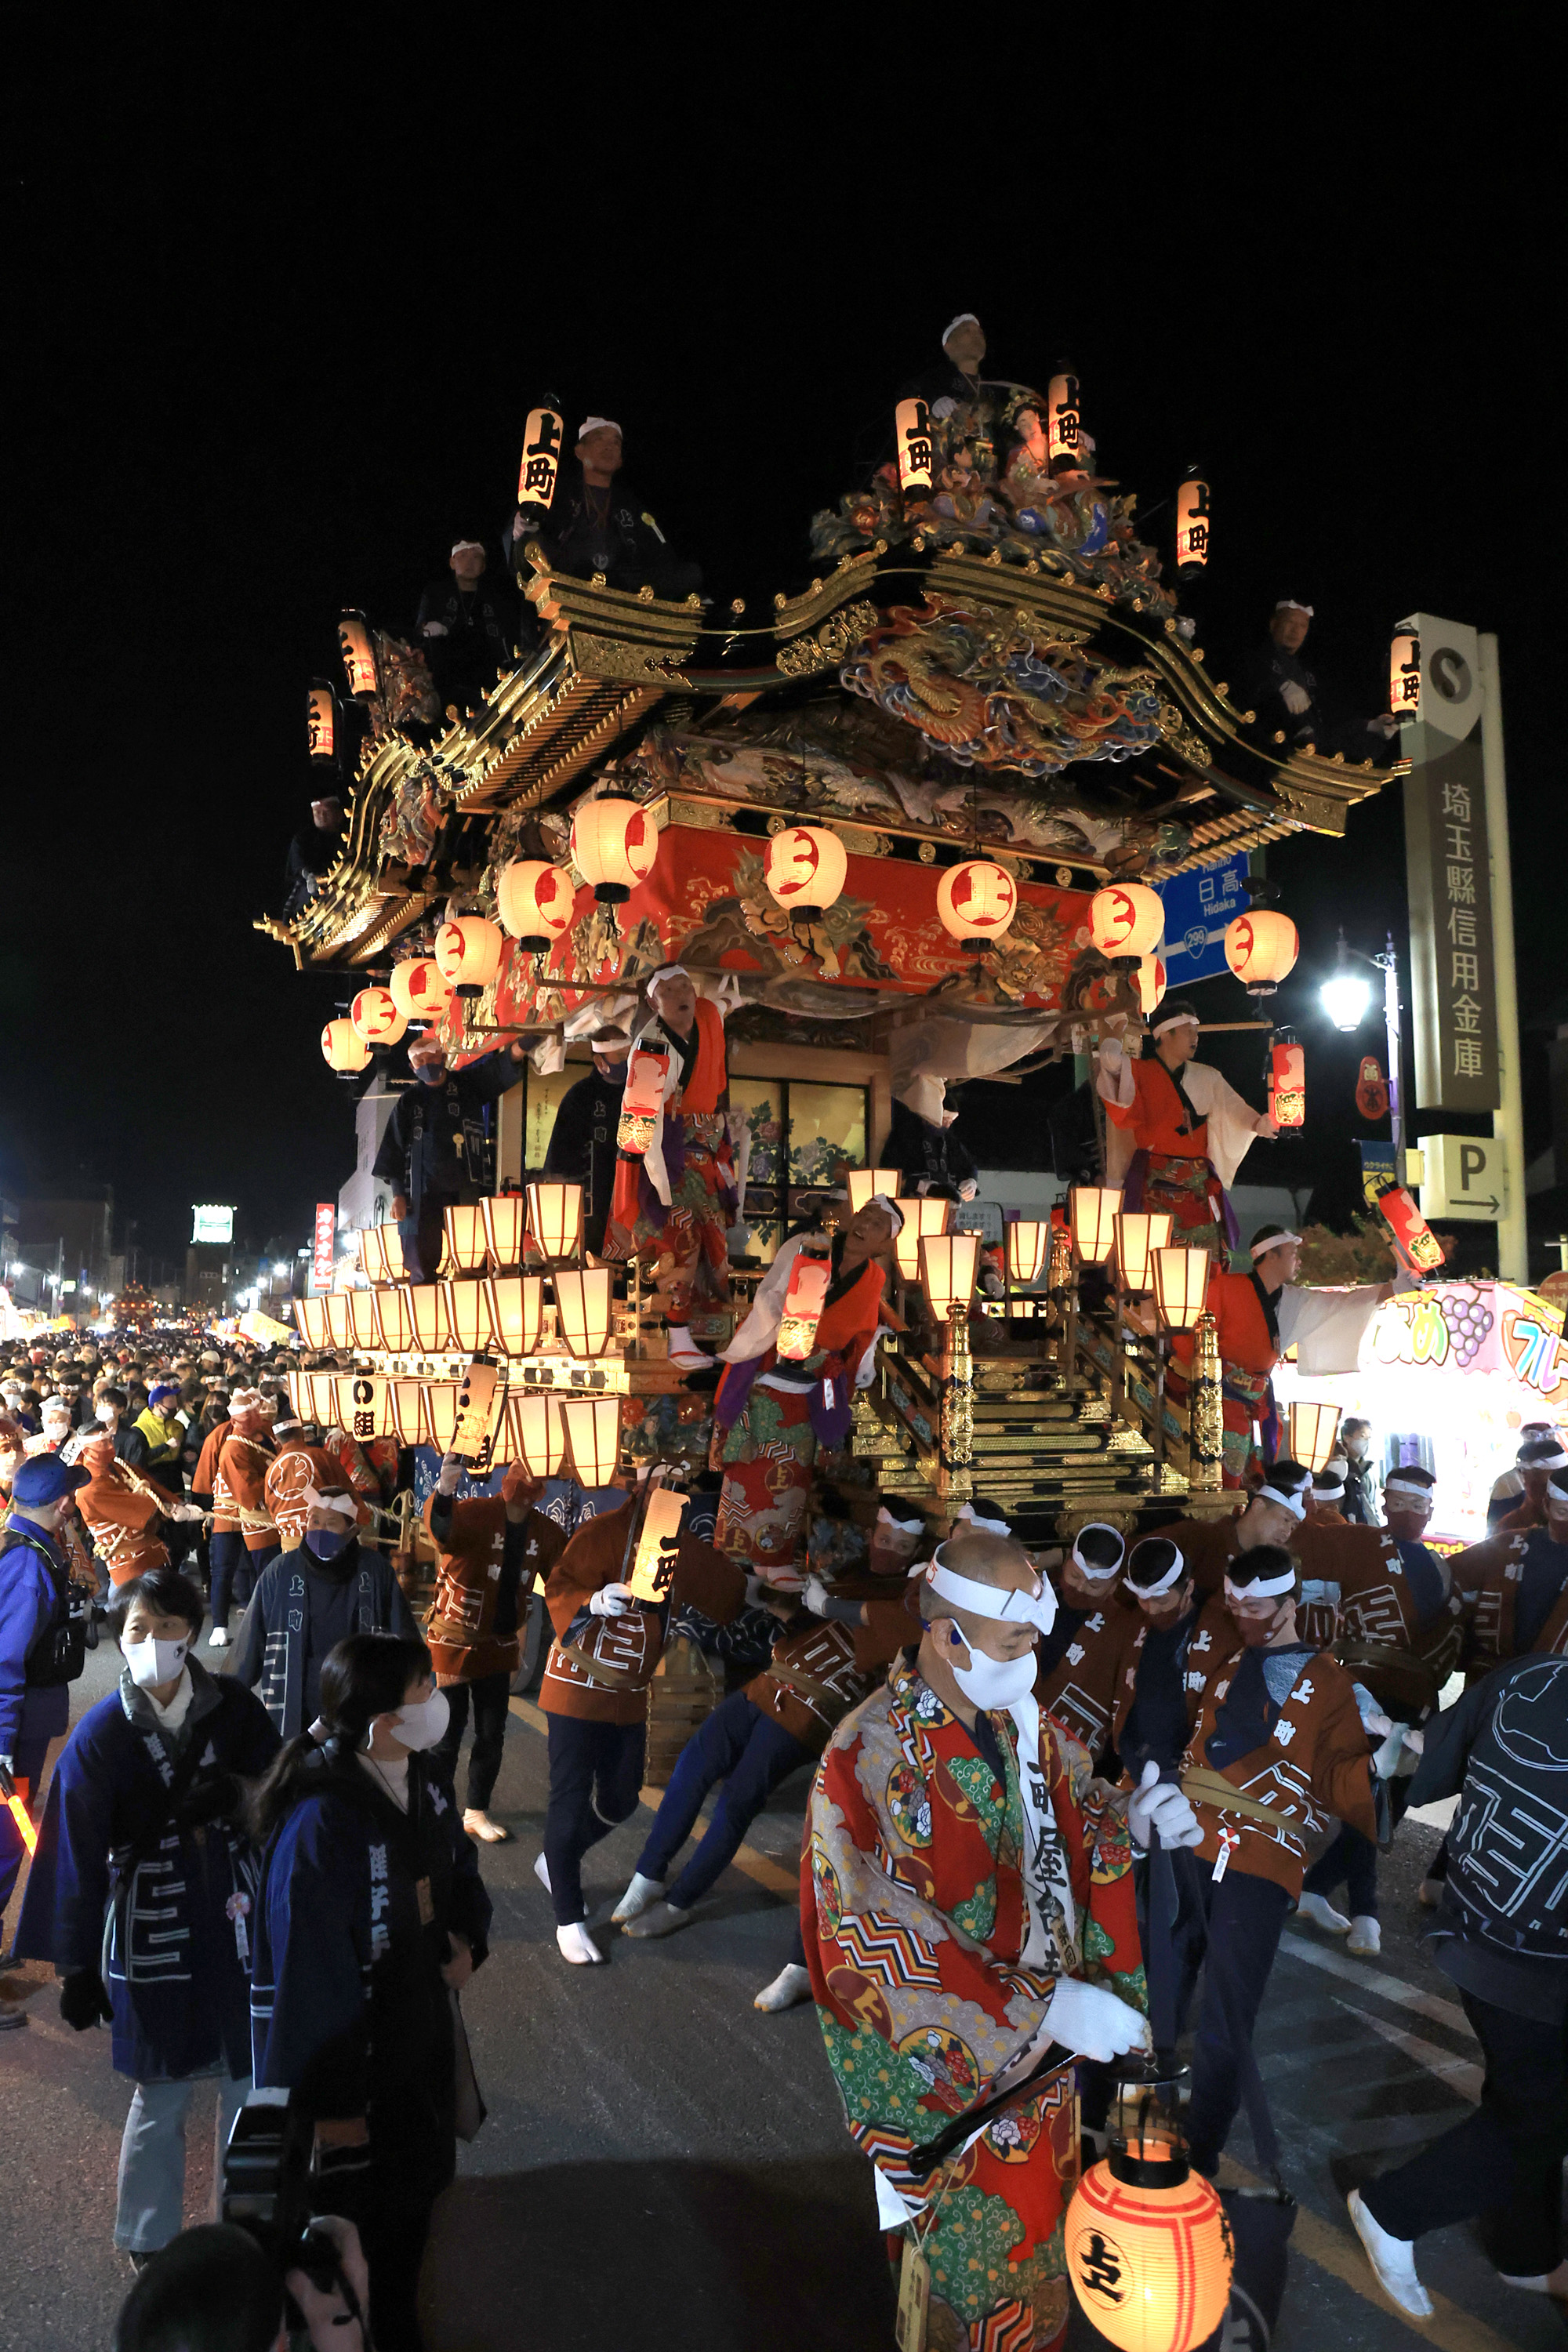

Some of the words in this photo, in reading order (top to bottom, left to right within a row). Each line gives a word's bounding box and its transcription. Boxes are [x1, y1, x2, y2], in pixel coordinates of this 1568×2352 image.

[524, 412, 560, 499] 上町
[1200, 869, 1239, 902] 日高
[1204, 898, 1236, 916] Hidaka
[1188, 930, 1205, 947] 299
[1442, 783, 1483, 1078] 埼玉縣信用金庫
[593, 1100, 608, 1143] 上町
[1461, 1144, 1486, 1191] P
[317, 1208, 333, 1276] カラオケ
[289, 1574, 304, 1632] 上町
[1066, 1612, 1105, 1666] 上町
[1187, 1629, 1212, 1693] 上町
[1273, 1679, 1315, 1746] 上町
